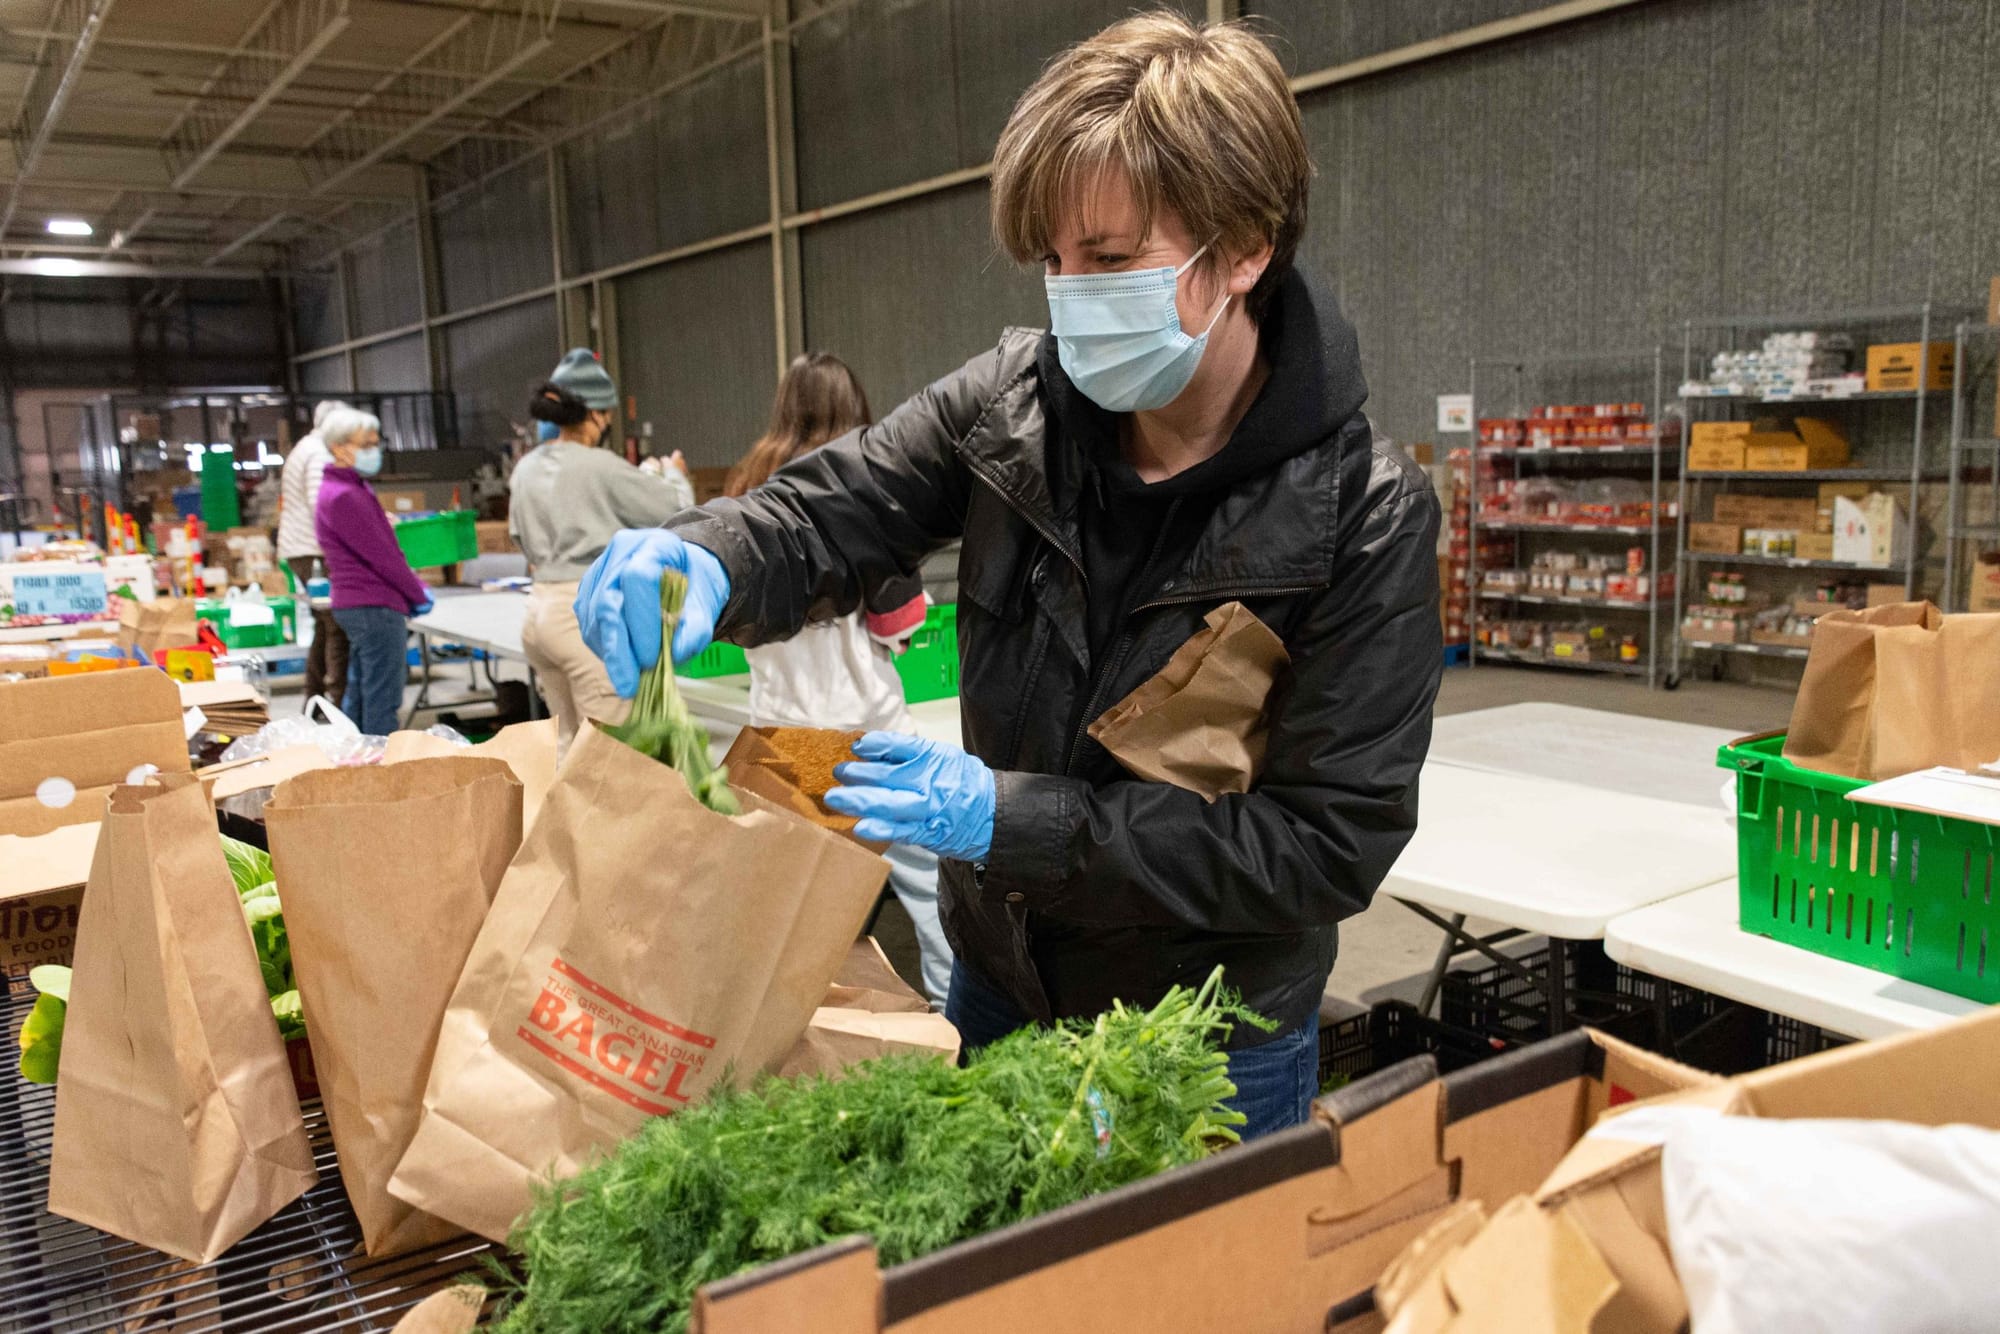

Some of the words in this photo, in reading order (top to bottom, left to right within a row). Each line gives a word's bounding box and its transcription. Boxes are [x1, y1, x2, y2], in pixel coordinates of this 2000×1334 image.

[12, 935, 76, 957] FOOD
[528, 988, 691, 1103] BAGEL
[547, 975, 576, 1001] THE
[577, 996, 624, 1030] GREAT
[626, 1025, 706, 1067] CANADIAN
